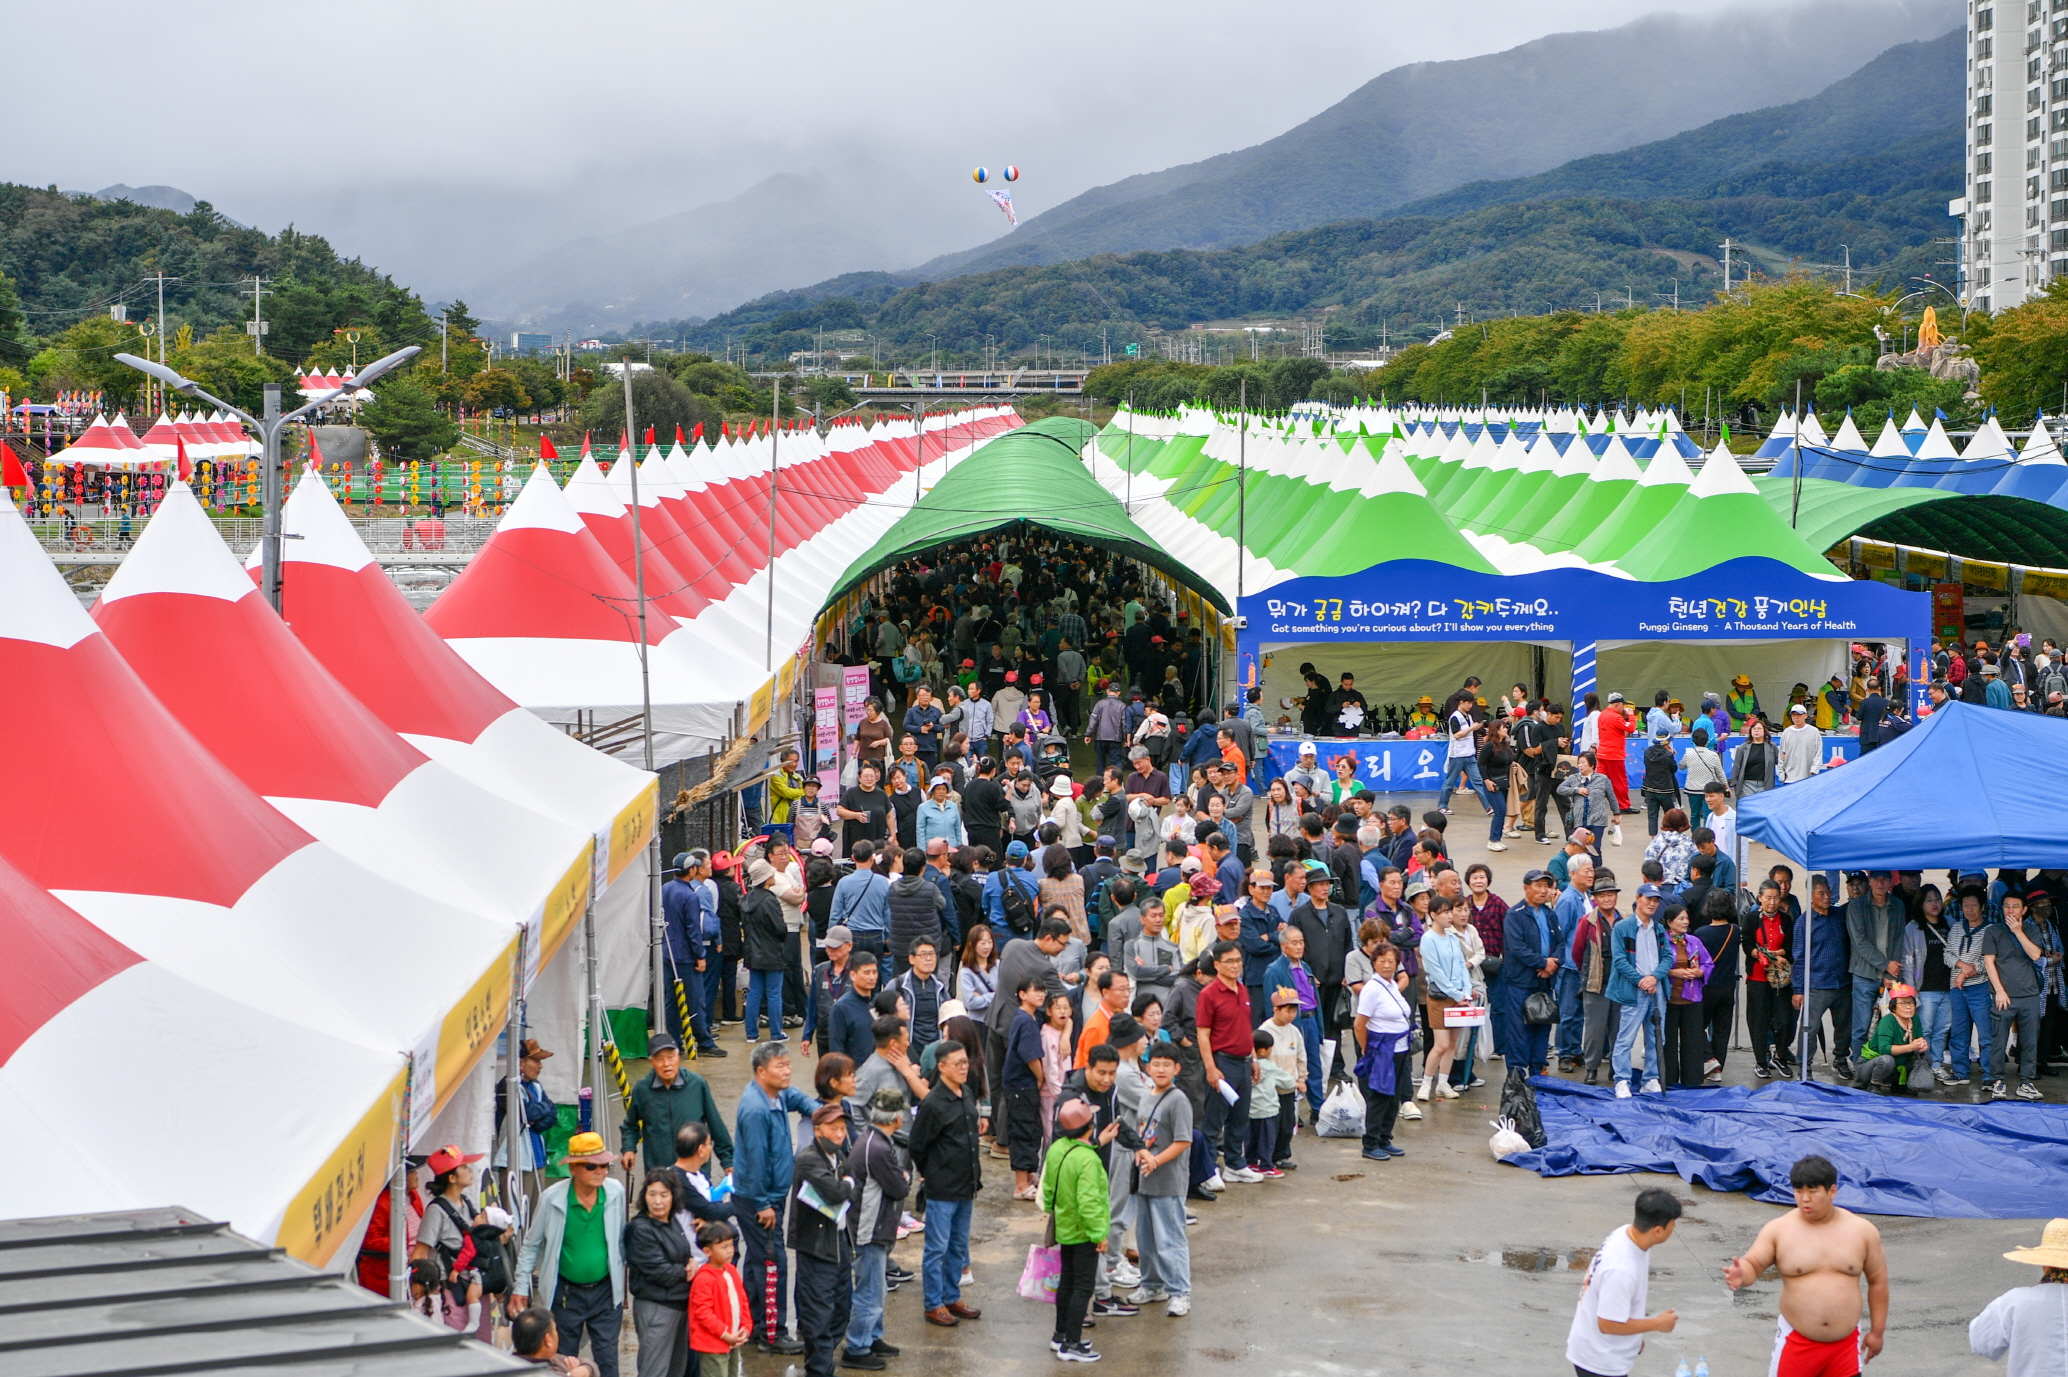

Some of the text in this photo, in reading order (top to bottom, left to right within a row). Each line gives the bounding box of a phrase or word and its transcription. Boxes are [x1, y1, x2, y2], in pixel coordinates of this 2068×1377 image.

[1267, 599, 1308, 619] 뭐가
[1313, 598, 1343, 622] 궁금
[1427, 600, 1449, 617] 다
[1668, 596, 1827, 620] 천년건강 풍기인삼
[1271, 621, 1555, 634] Got something you're curious about? I'll show you everything
[1639, 622, 1670, 632] Punggi
[1672, 622, 1709, 632] Ginseng
[1724, 621, 1732, 631] A
[1734, 621, 1778, 631] Thousand
[1781, 620, 1808, 630] Years
[1810, 620, 1822, 630] of
[1824, 620, 1857, 630] Health
[845, 685, 867, 705] 무료
[816, 708, 836, 730] 무료
